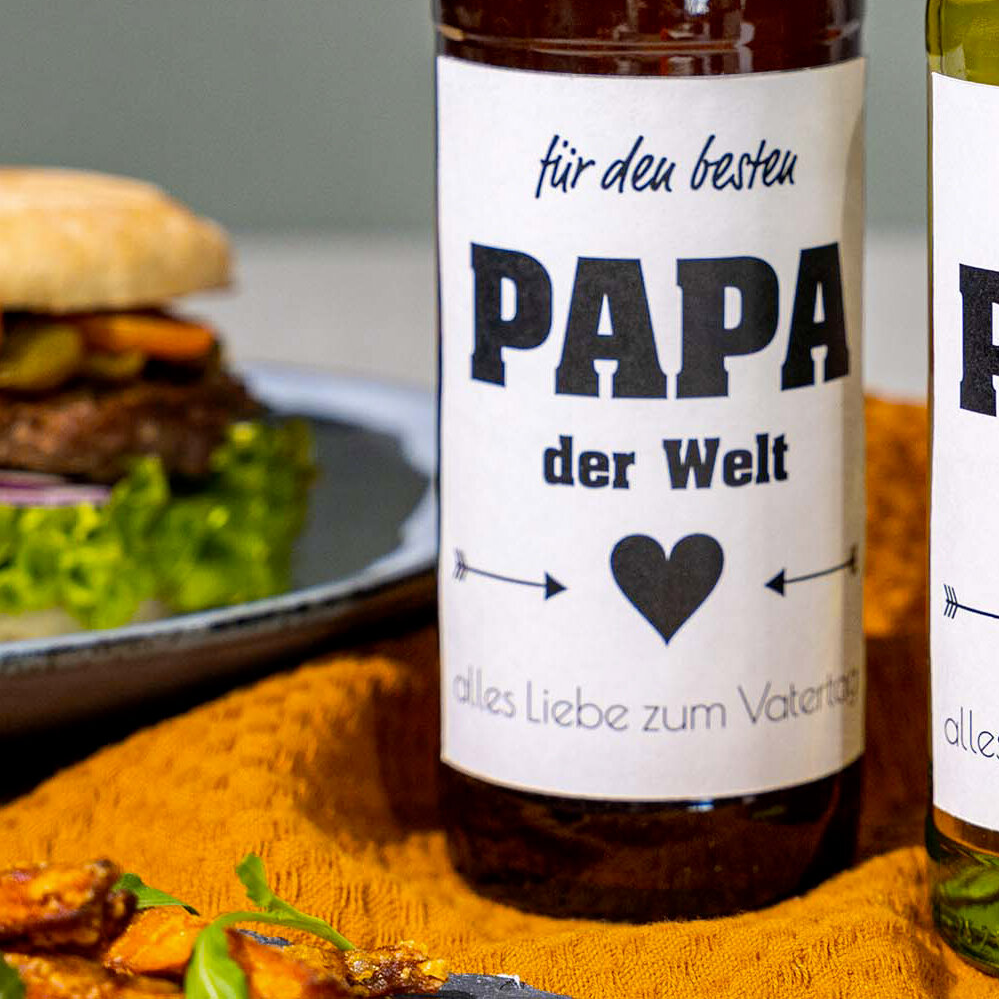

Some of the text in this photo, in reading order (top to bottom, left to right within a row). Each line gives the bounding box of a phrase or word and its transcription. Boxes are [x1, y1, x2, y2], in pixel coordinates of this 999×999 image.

[535, 135, 797, 198] für den besten
[471, 242, 851, 400] PAPA
[543, 433, 788, 489] der Welt
[453, 667, 516, 719] alles
[527, 681, 628, 732] Liebe
[642, 703, 726, 732] zum
